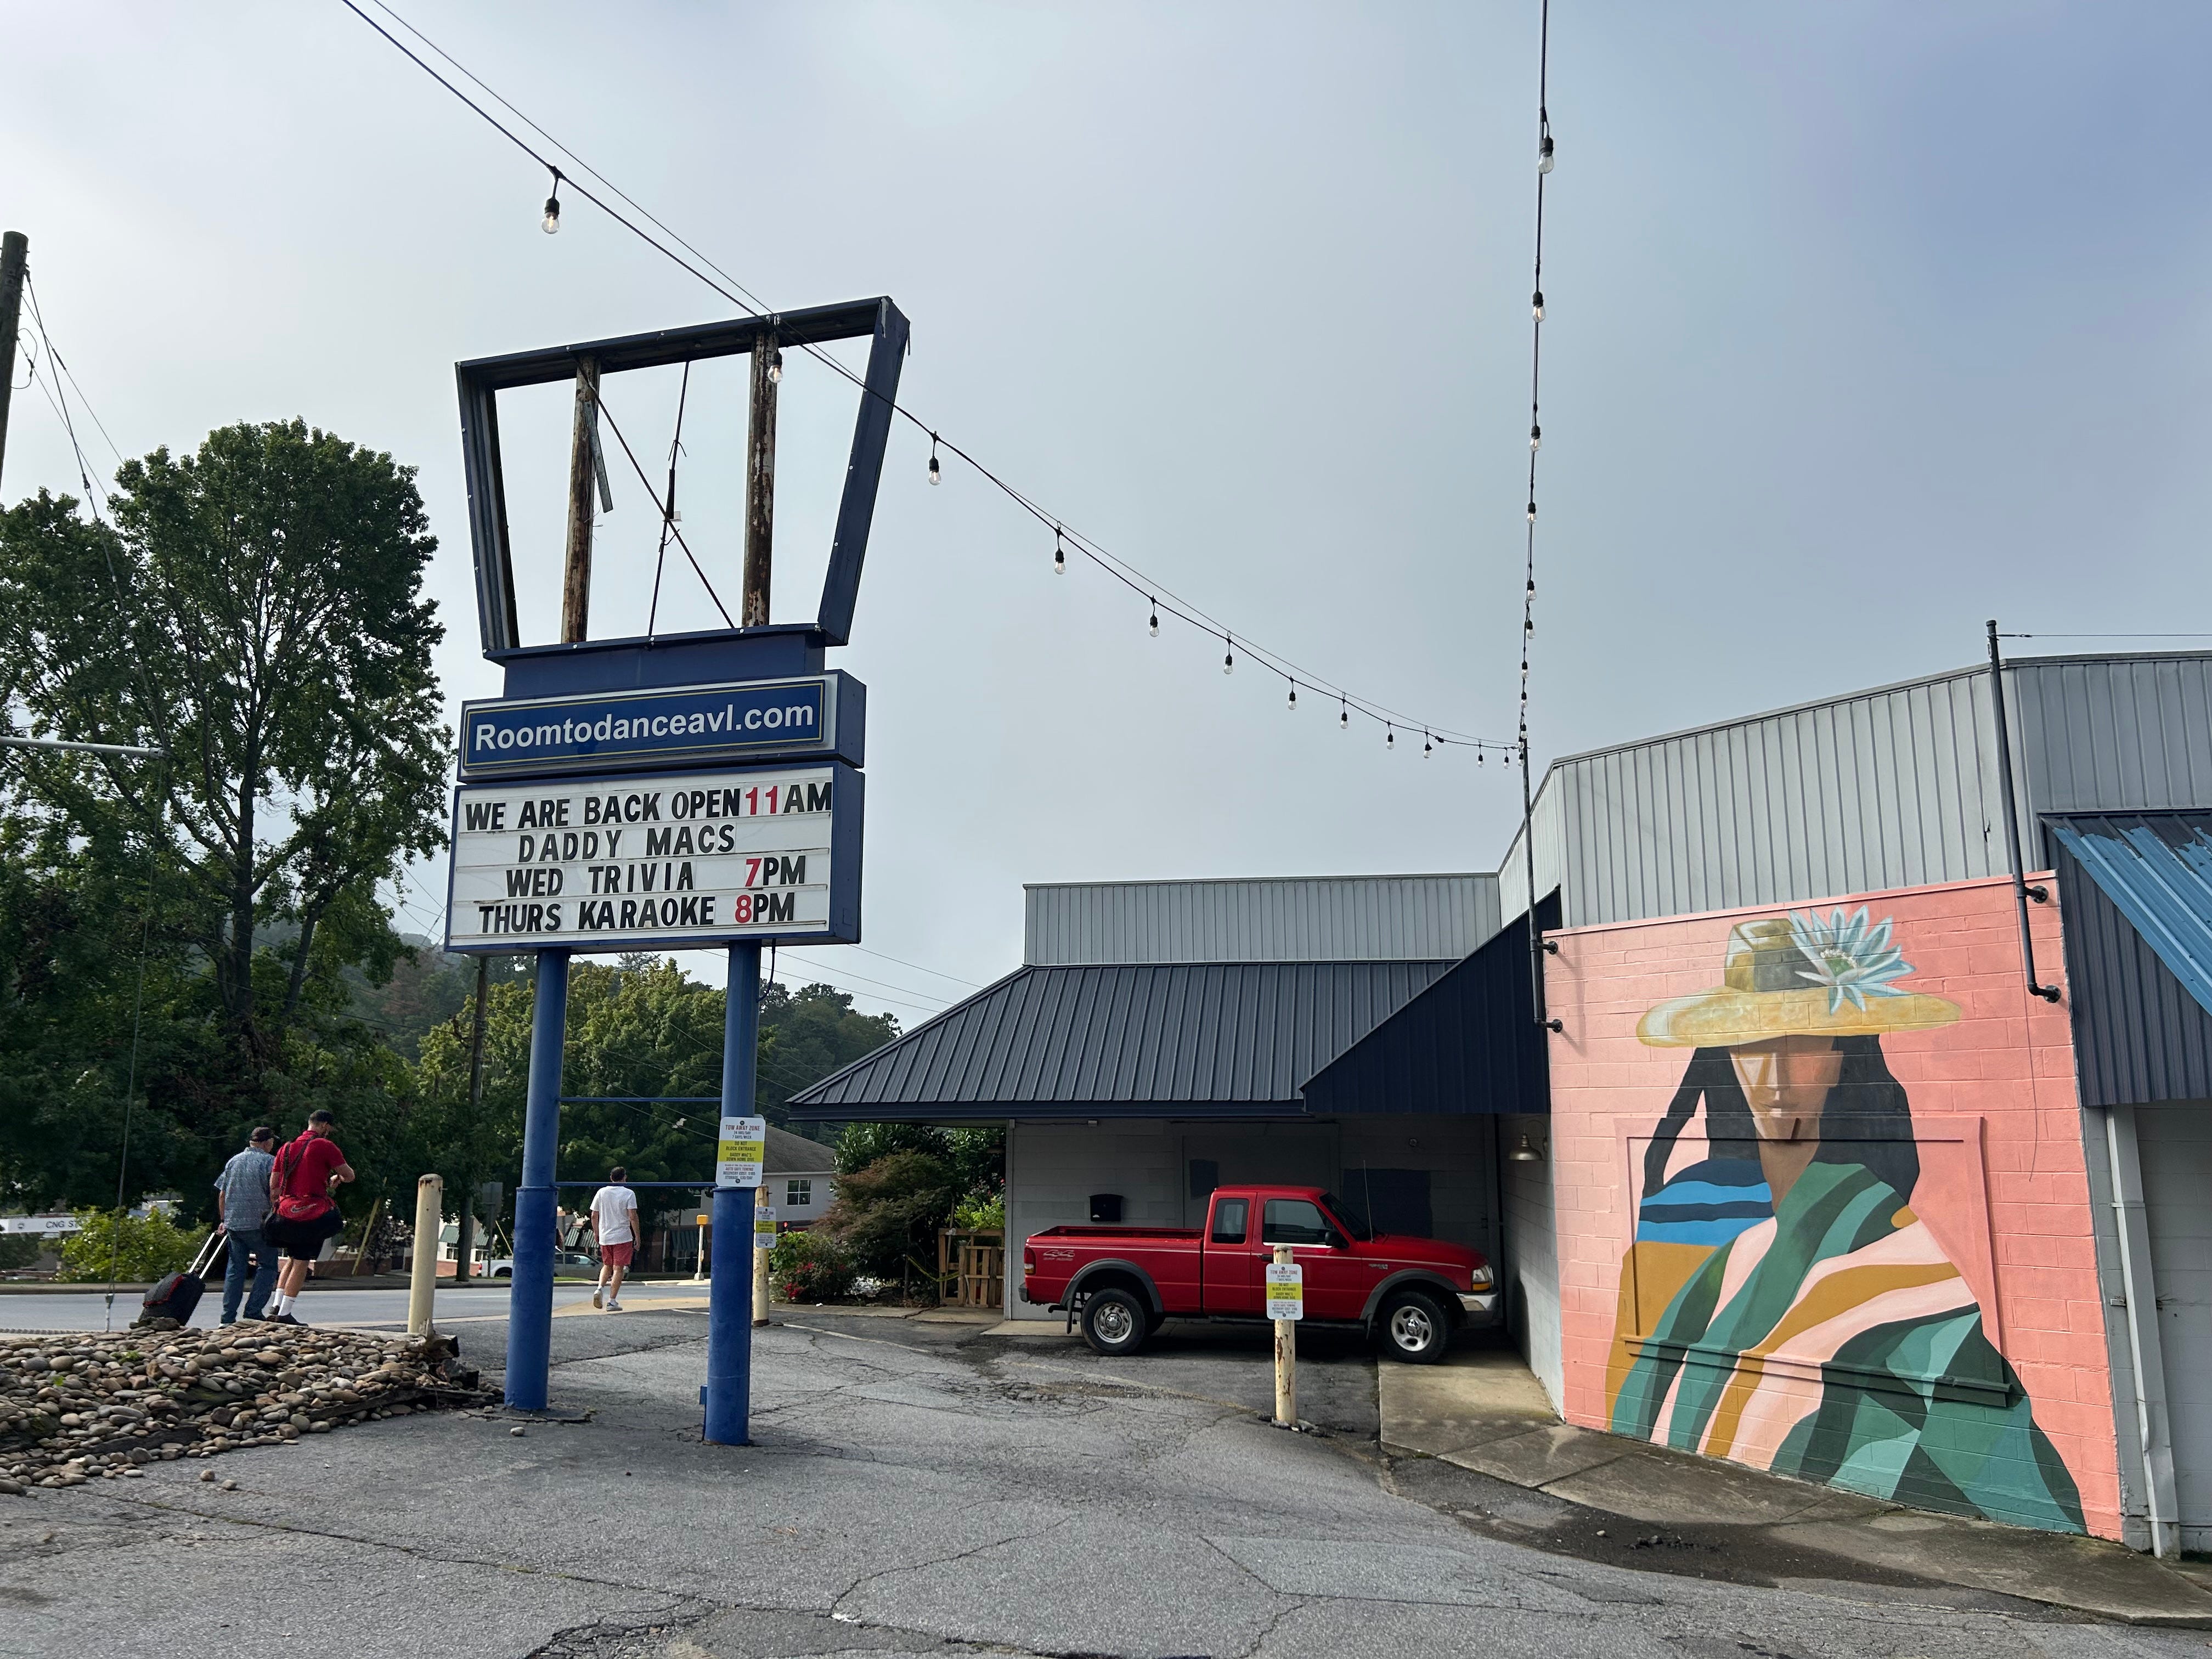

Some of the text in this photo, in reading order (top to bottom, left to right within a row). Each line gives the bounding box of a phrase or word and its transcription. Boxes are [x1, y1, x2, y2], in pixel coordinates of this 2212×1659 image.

[476, 704, 814, 751] Roomtodanceavl.com
[466, 782, 832, 831] WE ARE BACK OPEN 11AM
[518, 824, 735, 862] DADDY MACS
[506, 855, 806, 898] WED TRIVIA 7PM
[478, 892, 795, 933] THURS KARAOKE 8PM
[46, 1220, 65, 1228] CNG
